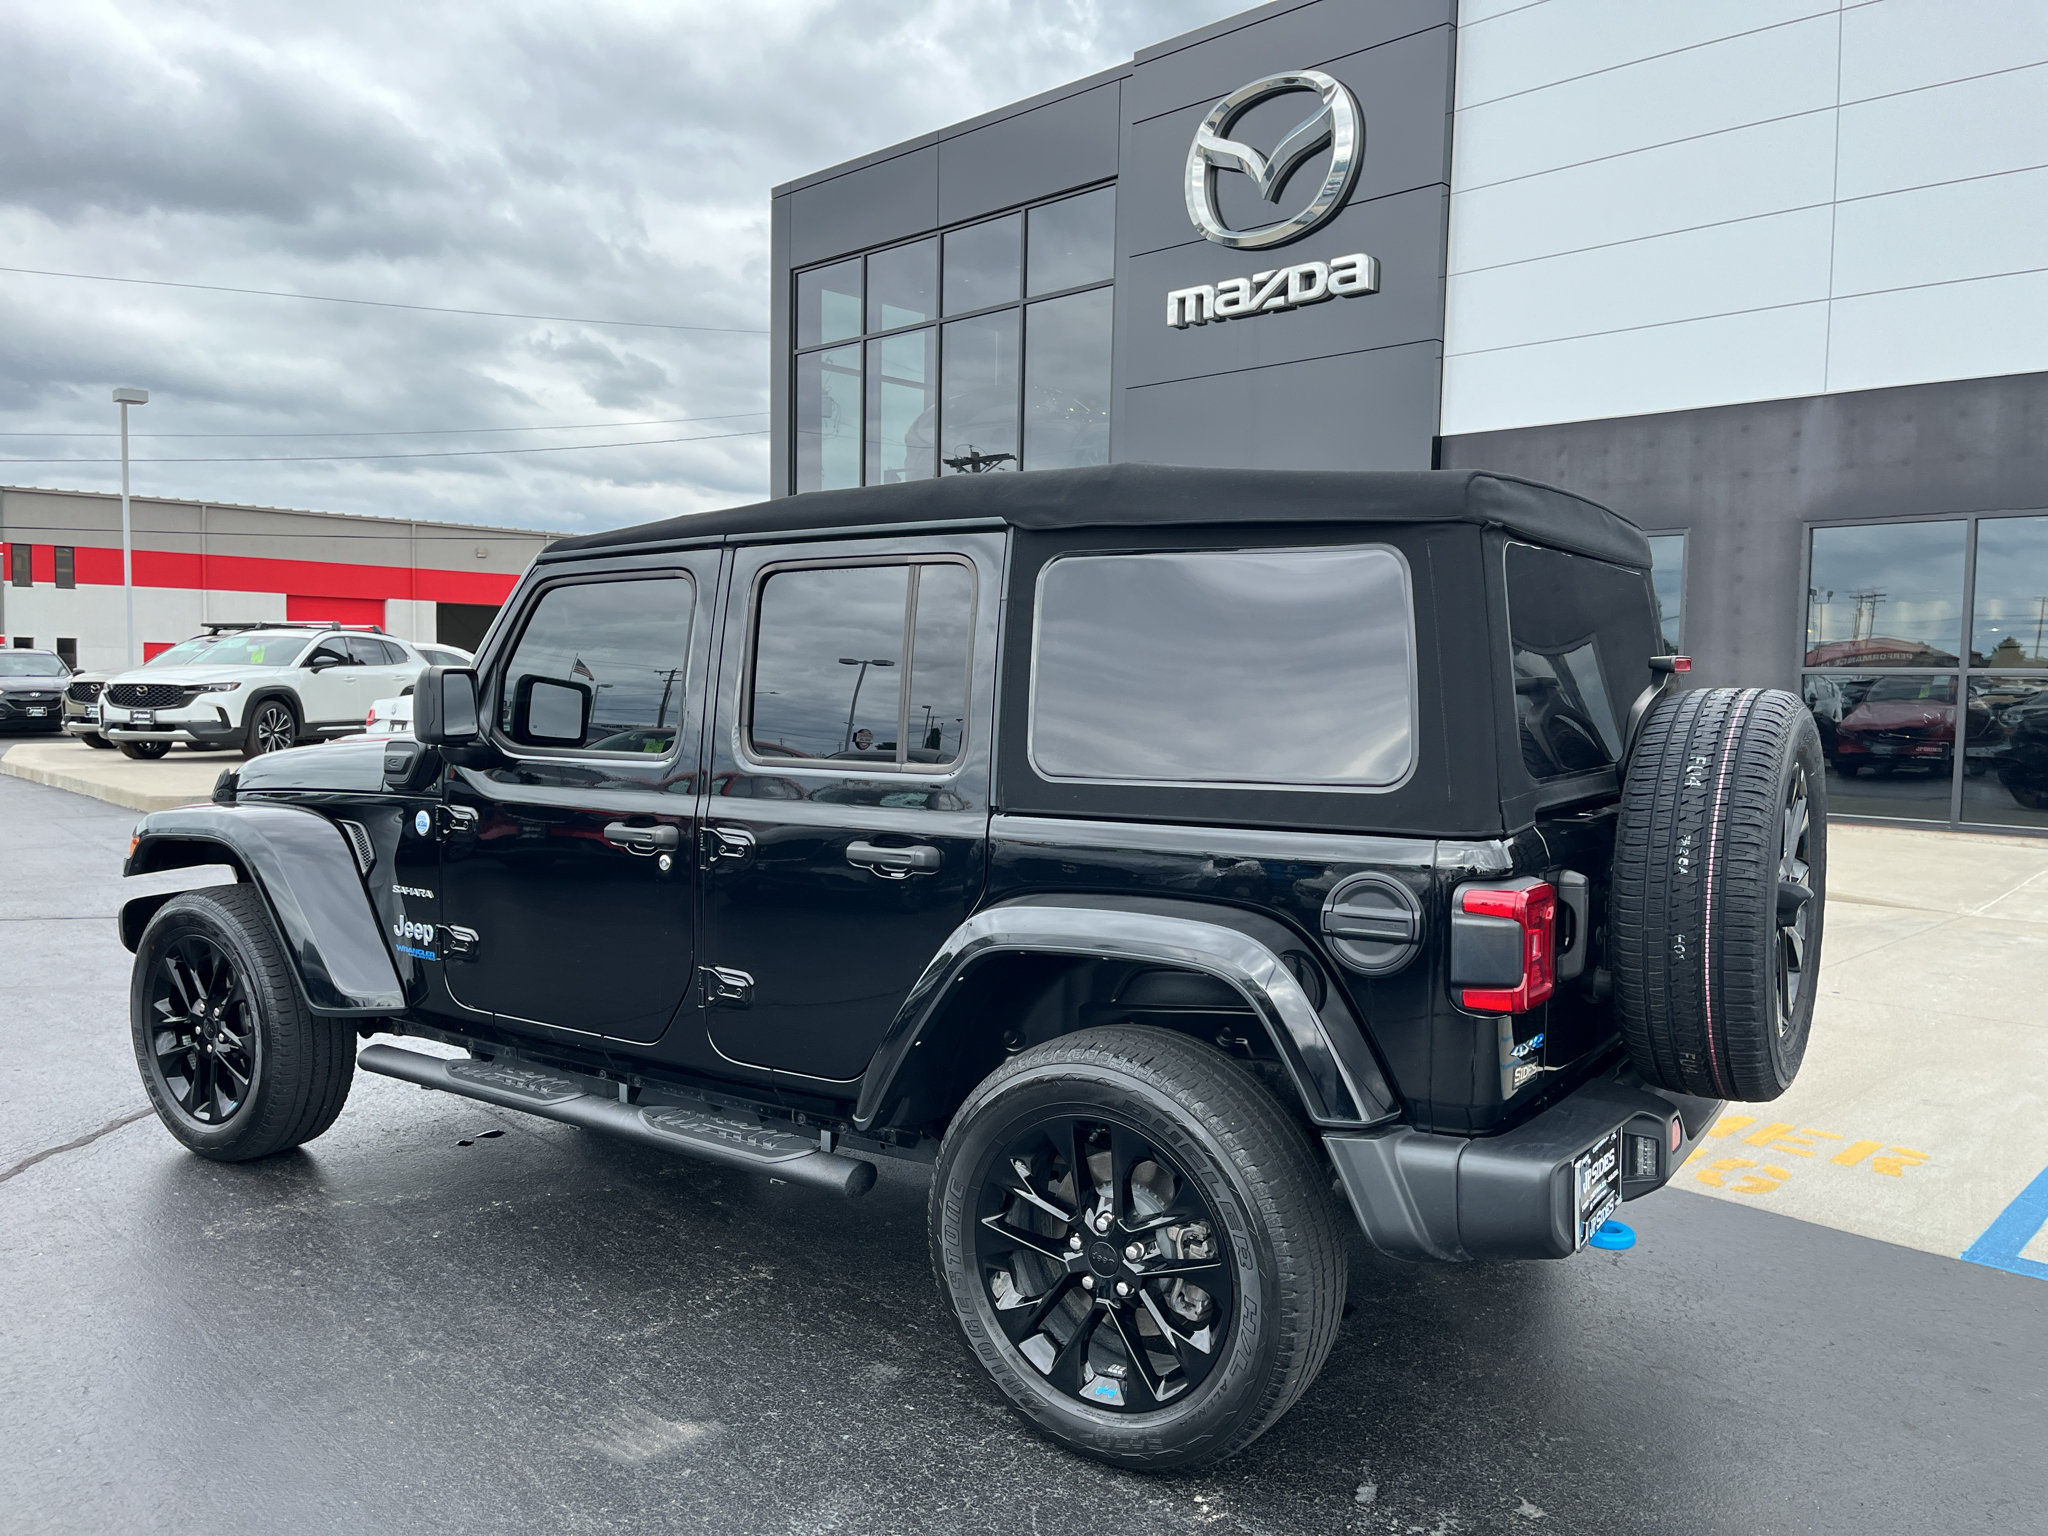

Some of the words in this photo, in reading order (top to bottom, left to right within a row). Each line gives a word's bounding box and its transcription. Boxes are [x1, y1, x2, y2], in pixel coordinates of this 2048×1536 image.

[392, 885, 434, 898] SAHARA
[393, 914, 434, 946] Jeep
[395, 943, 436, 959] WRANGLER
[1122, 1099, 1254, 1271] DUELER
[944, 1176, 1050, 1417] BRIDGESTONE
